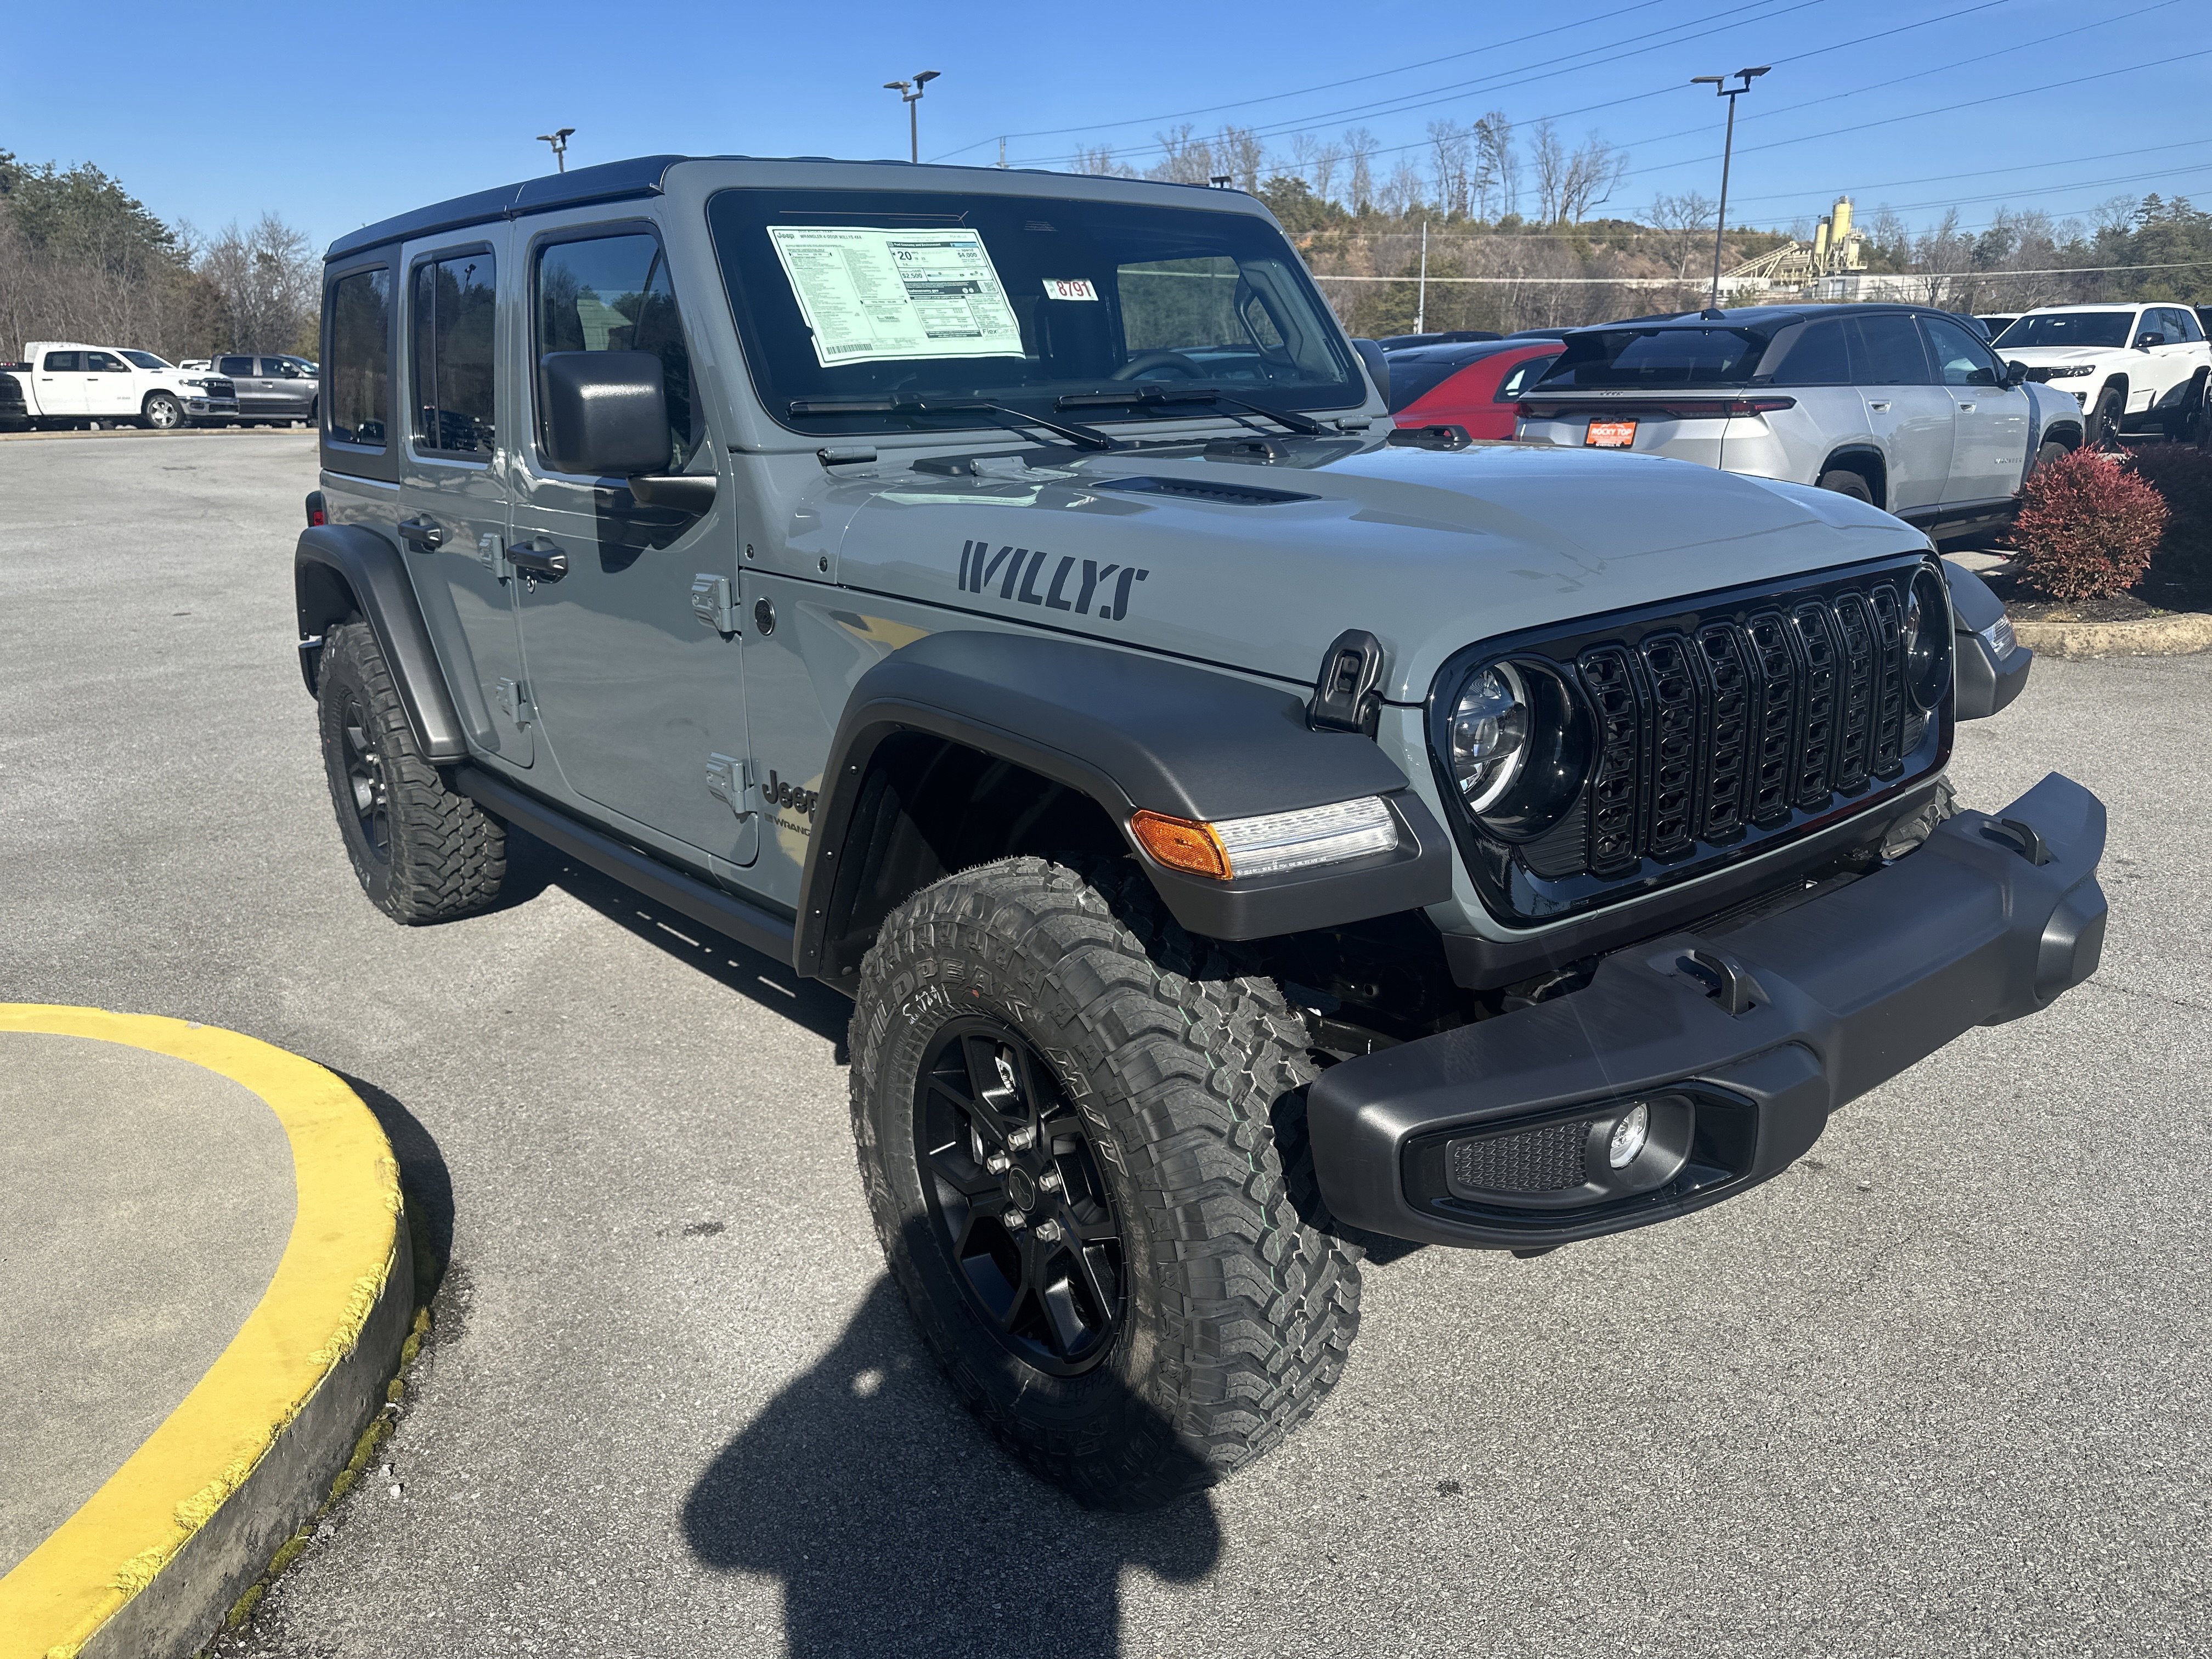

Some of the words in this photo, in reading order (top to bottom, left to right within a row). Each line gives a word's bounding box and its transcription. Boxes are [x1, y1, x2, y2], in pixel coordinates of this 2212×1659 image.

[898, 251, 912, 261] 20
[1056, 280, 1091, 297] 8791
[958, 540, 1149, 620] WILLYS
